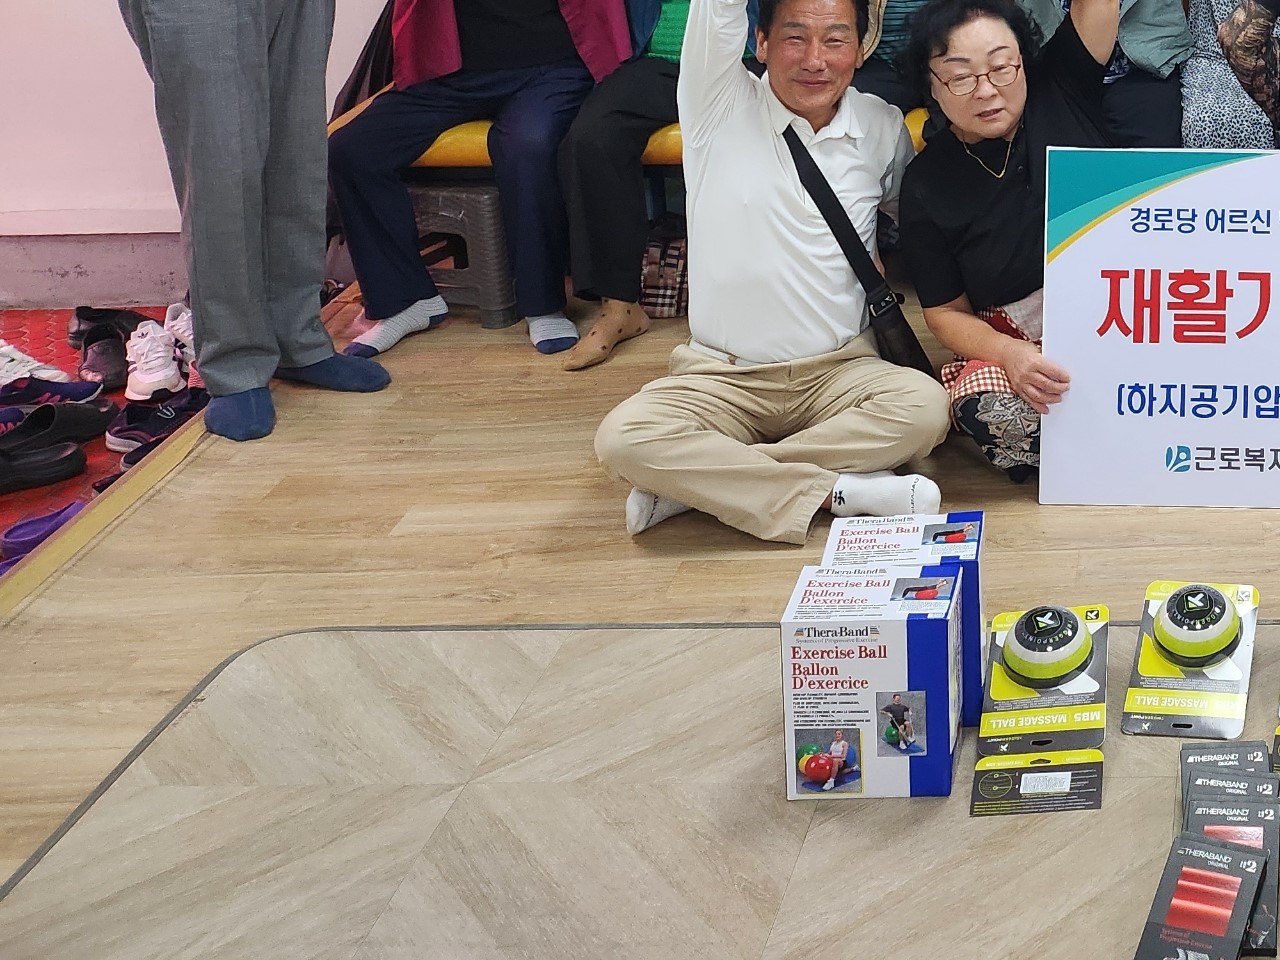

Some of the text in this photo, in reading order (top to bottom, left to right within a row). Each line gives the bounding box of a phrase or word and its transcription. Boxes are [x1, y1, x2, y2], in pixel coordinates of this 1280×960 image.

[1130, 207, 1198, 233] 경로당
[1205, 208, 1273, 235] 어르신
[840, 526, 920, 537] Exercise Ball
[835, 542, 901, 552] D'exercice
[837, 537, 877, 546] Ballon
[806, 579, 891, 588] Exercise Ball
[802, 589, 844, 598] Ballon
[799, 596, 869, 605] D'exercice
[790, 644, 888, 660] Exercise Ball
[792, 662, 839, 677] Ballon
[792, 675, 869, 690] D'exercice
[1135, 695, 1209, 708] MASSAGE BALL
[990, 709, 1101, 730] MB5 MASSAGE BALL
[1193, 753, 1239, 762] THERABAND
[1202, 778, 1249, 789] THERABAND
[1202, 807, 1249, 817] THERABAND
[1184, 848, 1232, 864] THERABAND
